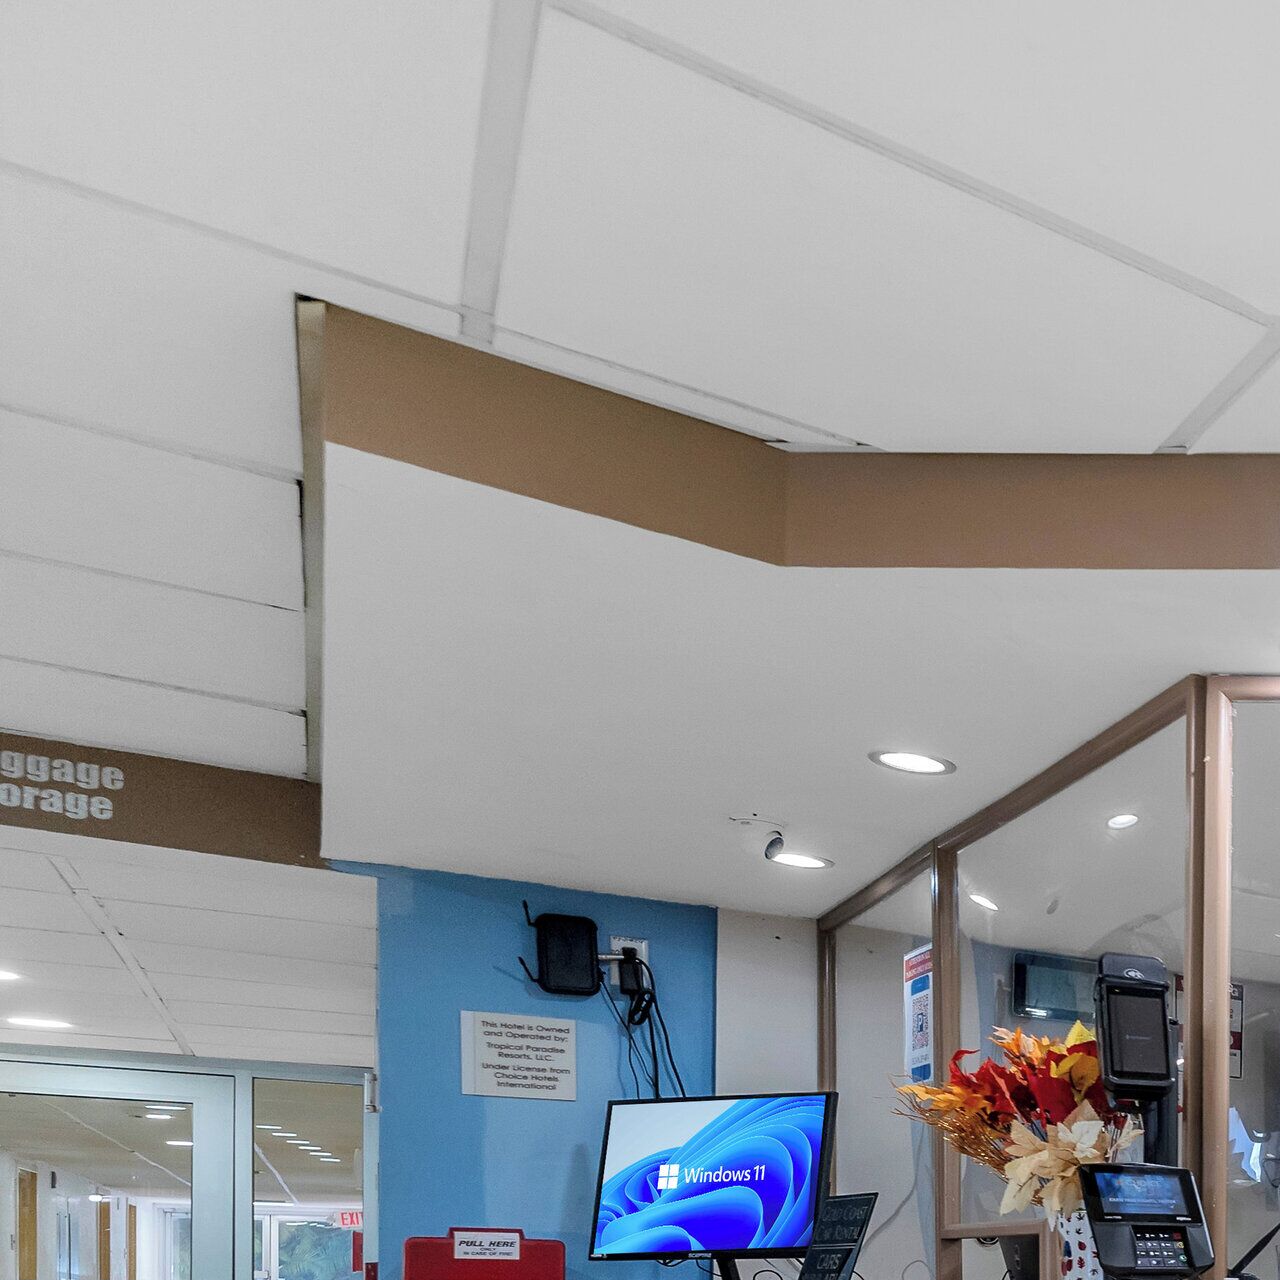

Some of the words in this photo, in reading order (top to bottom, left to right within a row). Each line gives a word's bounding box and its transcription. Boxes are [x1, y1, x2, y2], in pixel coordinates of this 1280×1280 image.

[481, 1020, 497, 1028] This
[500, 1022, 525, 1030] Hotel
[536, 1025, 570, 1034] Owned
[505, 1031, 552, 1041] Operated
[486, 1041, 523, 1050] Tropical
[526, 1045, 565, 1054] Paradise
[481, 1062, 509, 1070] Under
[512, 1065, 547, 1073] License
[494, 1071, 528, 1080] Choice
[531, 1074, 559, 1082] Hotels
[496, 1081, 557, 1090] International
[684, 1165, 751, 1184] Windows
[753, 1164, 766, 1181] 11
[489, 1240, 517, 1248] HERE
